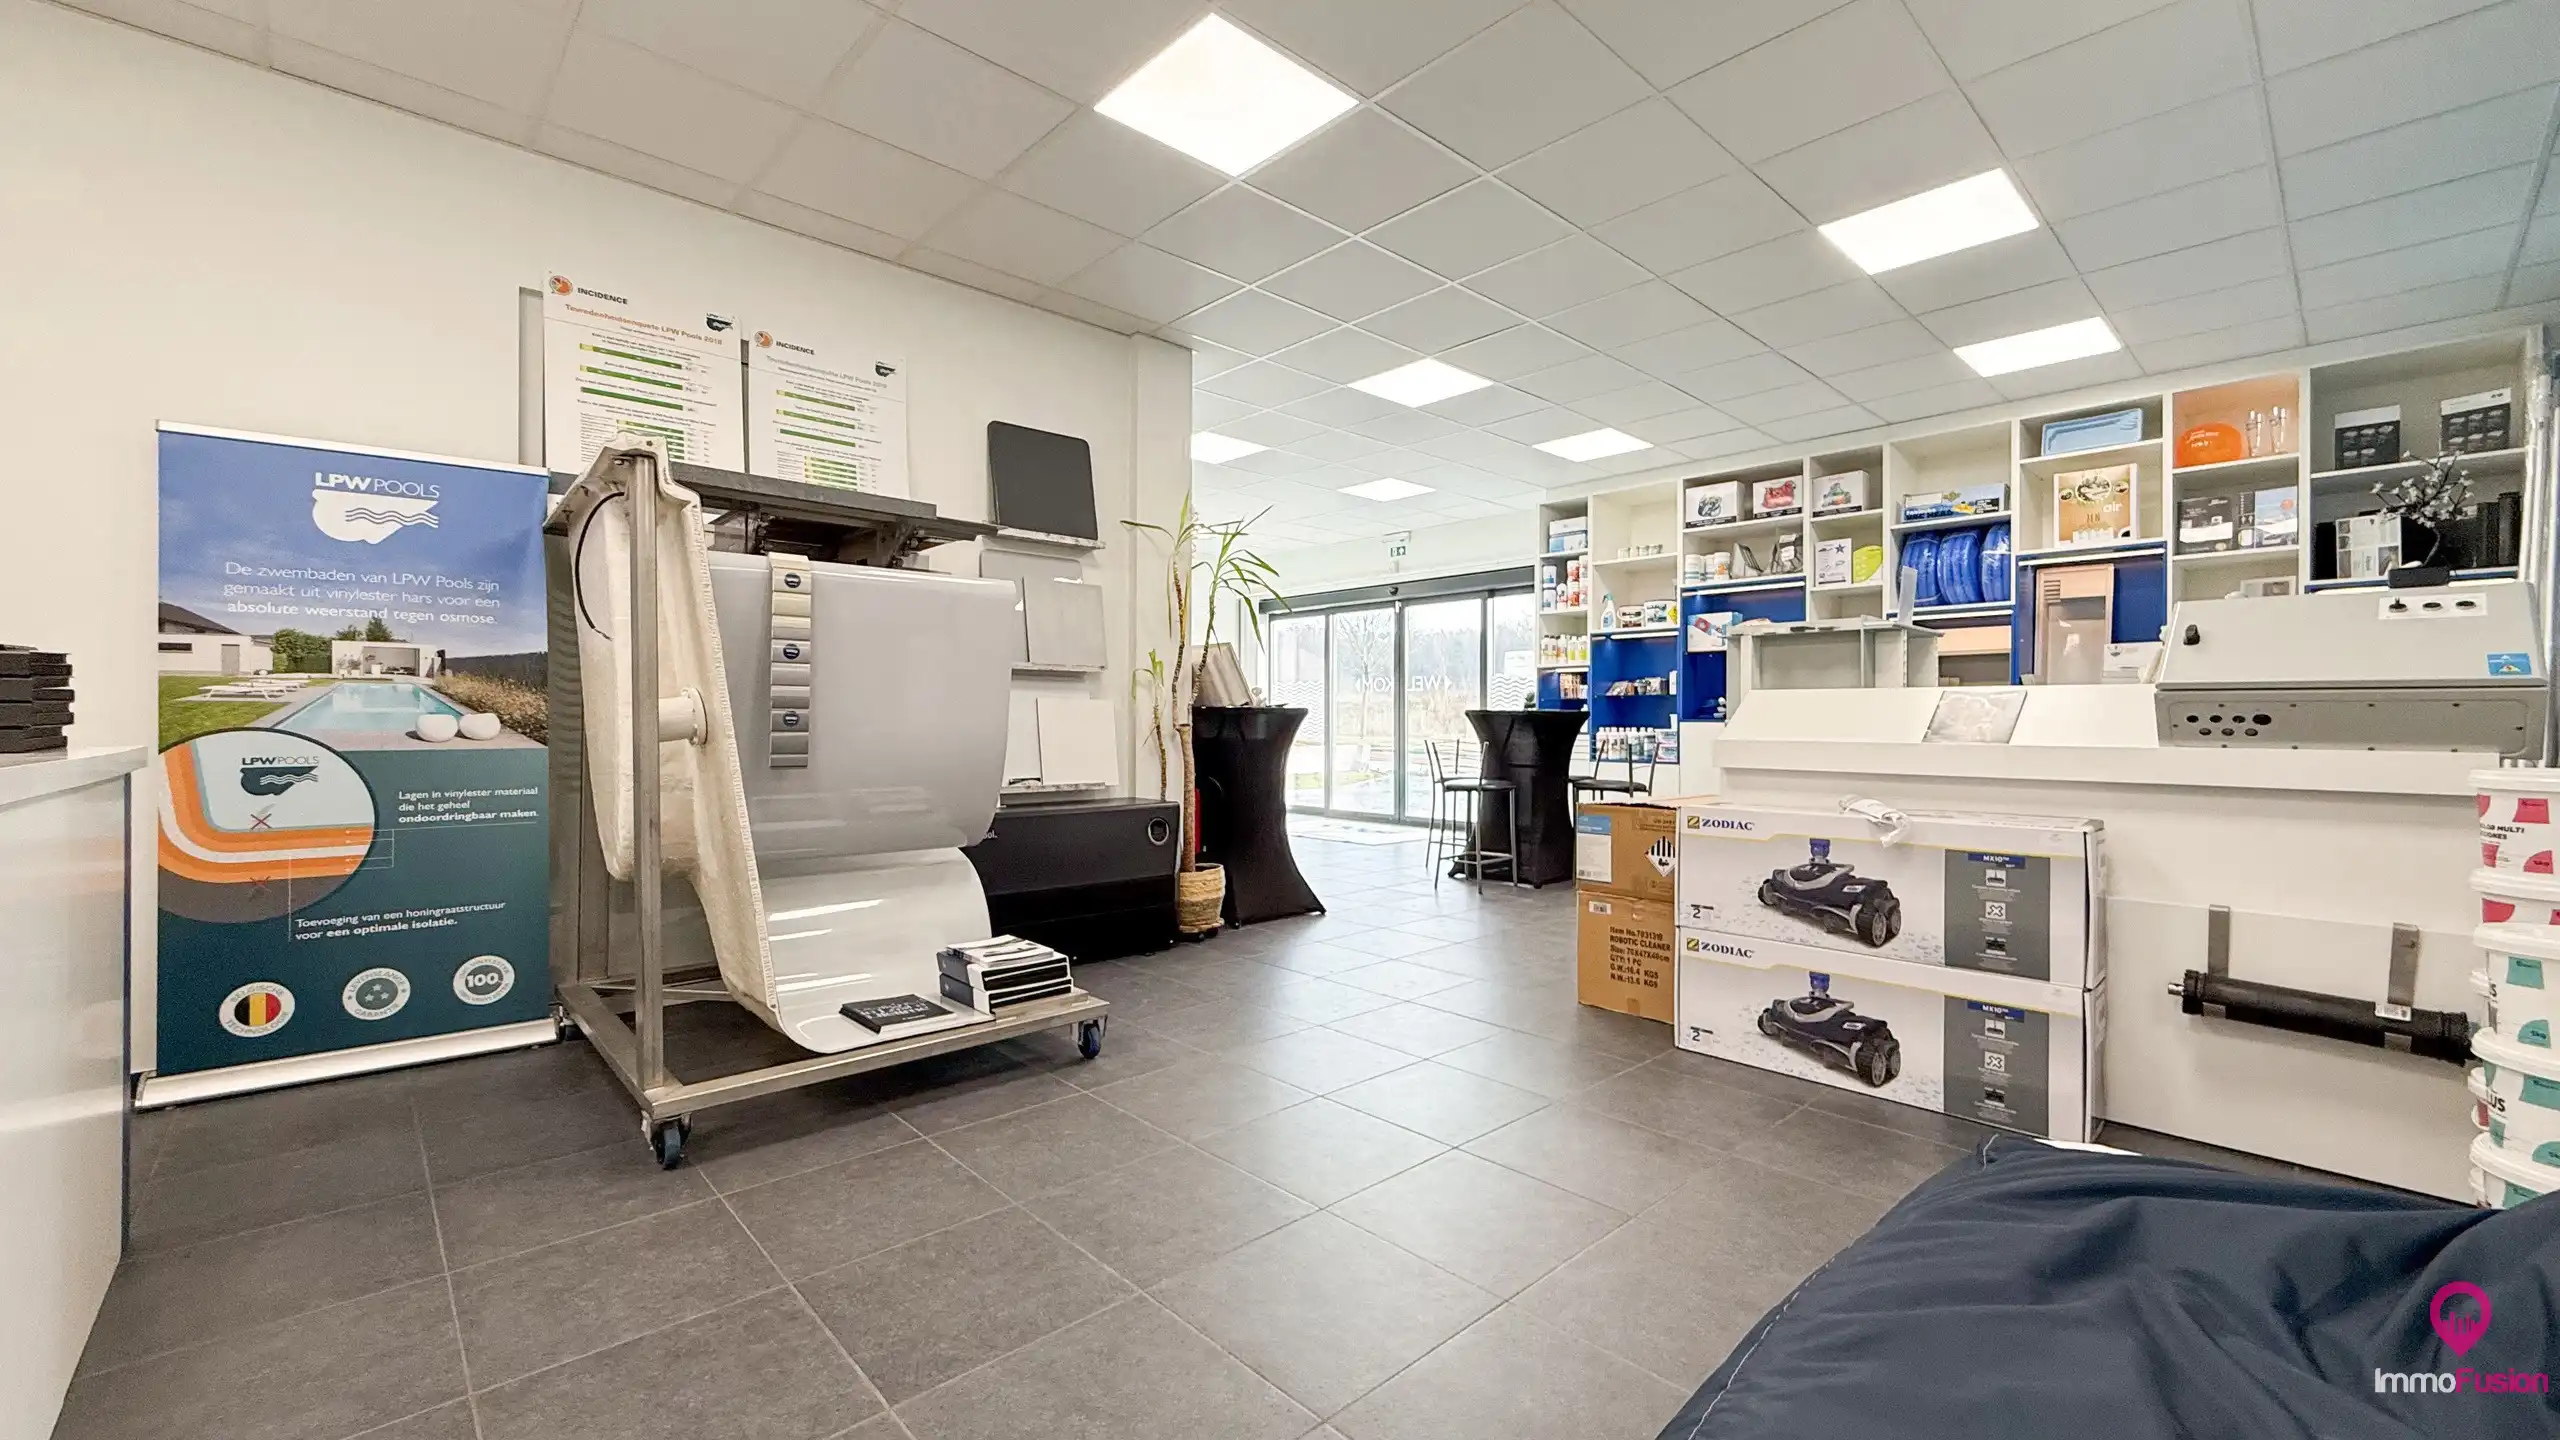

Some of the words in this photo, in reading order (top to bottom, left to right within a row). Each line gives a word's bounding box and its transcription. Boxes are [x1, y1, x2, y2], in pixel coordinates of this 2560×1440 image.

[577, 287, 628, 305] INCIDENCE
[776, 340, 815, 356] INCIDENCE
[225, 561, 253, 576] De
[257, 566, 356, 581] zwembaden
[360, 572, 388, 583] van
[392, 572, 431, 586] LPW
[436, 575, 474, 590] Pools
[477, 579, 500, 594] zijn
[223, 583, 296, 597] gemaakt
[300, 585, 321, 598] uit
[326, 587, 399, 603] vinylester
[401, 591, 433, 604] hars
[436, 596, 471, 606] voor
[474, 598, 500, 608] een
[227, 600, 300, 615] absolute
[304, 605, 388, 620] weerstand
[393, 610, 434, 624] tegen
[440, 613, 498, 625] osmose.
[398, 791, 429, 802] Lagen
[431, 790, 441, 799] in
[444, 788, 492, 799] vinylester
[494, 787, 538, 796] materiaal
[398, 803, 415, 811] die
[417, 802, 435, 811] het
[437, 800, 471, 812] geheel
[398, 811, 498, 823] ondoordringbaar
[499, 809, 539, 818] maken.
[1702, 818, 1754, 831] ZODIAC
[2497, 825, 2525, 834] MULTI
[295, 915, 359, 929] Toevoeging
[361, 913, 380, 922] van
[383, 910, 403, 920] een
[405, 902, 507, 919] honingraatstructuur
[295, 930, 323, 941] voor
[326, 928, 350, 938] een
[353, 922, 408, 936] optimale
[411, 917, 458, 930] isolatie.
[1609, 935, 1639, 947] ROBOTIC
[1639, 940, 1671, 952] CLEANER
[1701, 941, 1754, 958] ZODIAC
[1643, 969, 1659, 980] KGS
[1643, 978, 1658, 989] KGS
